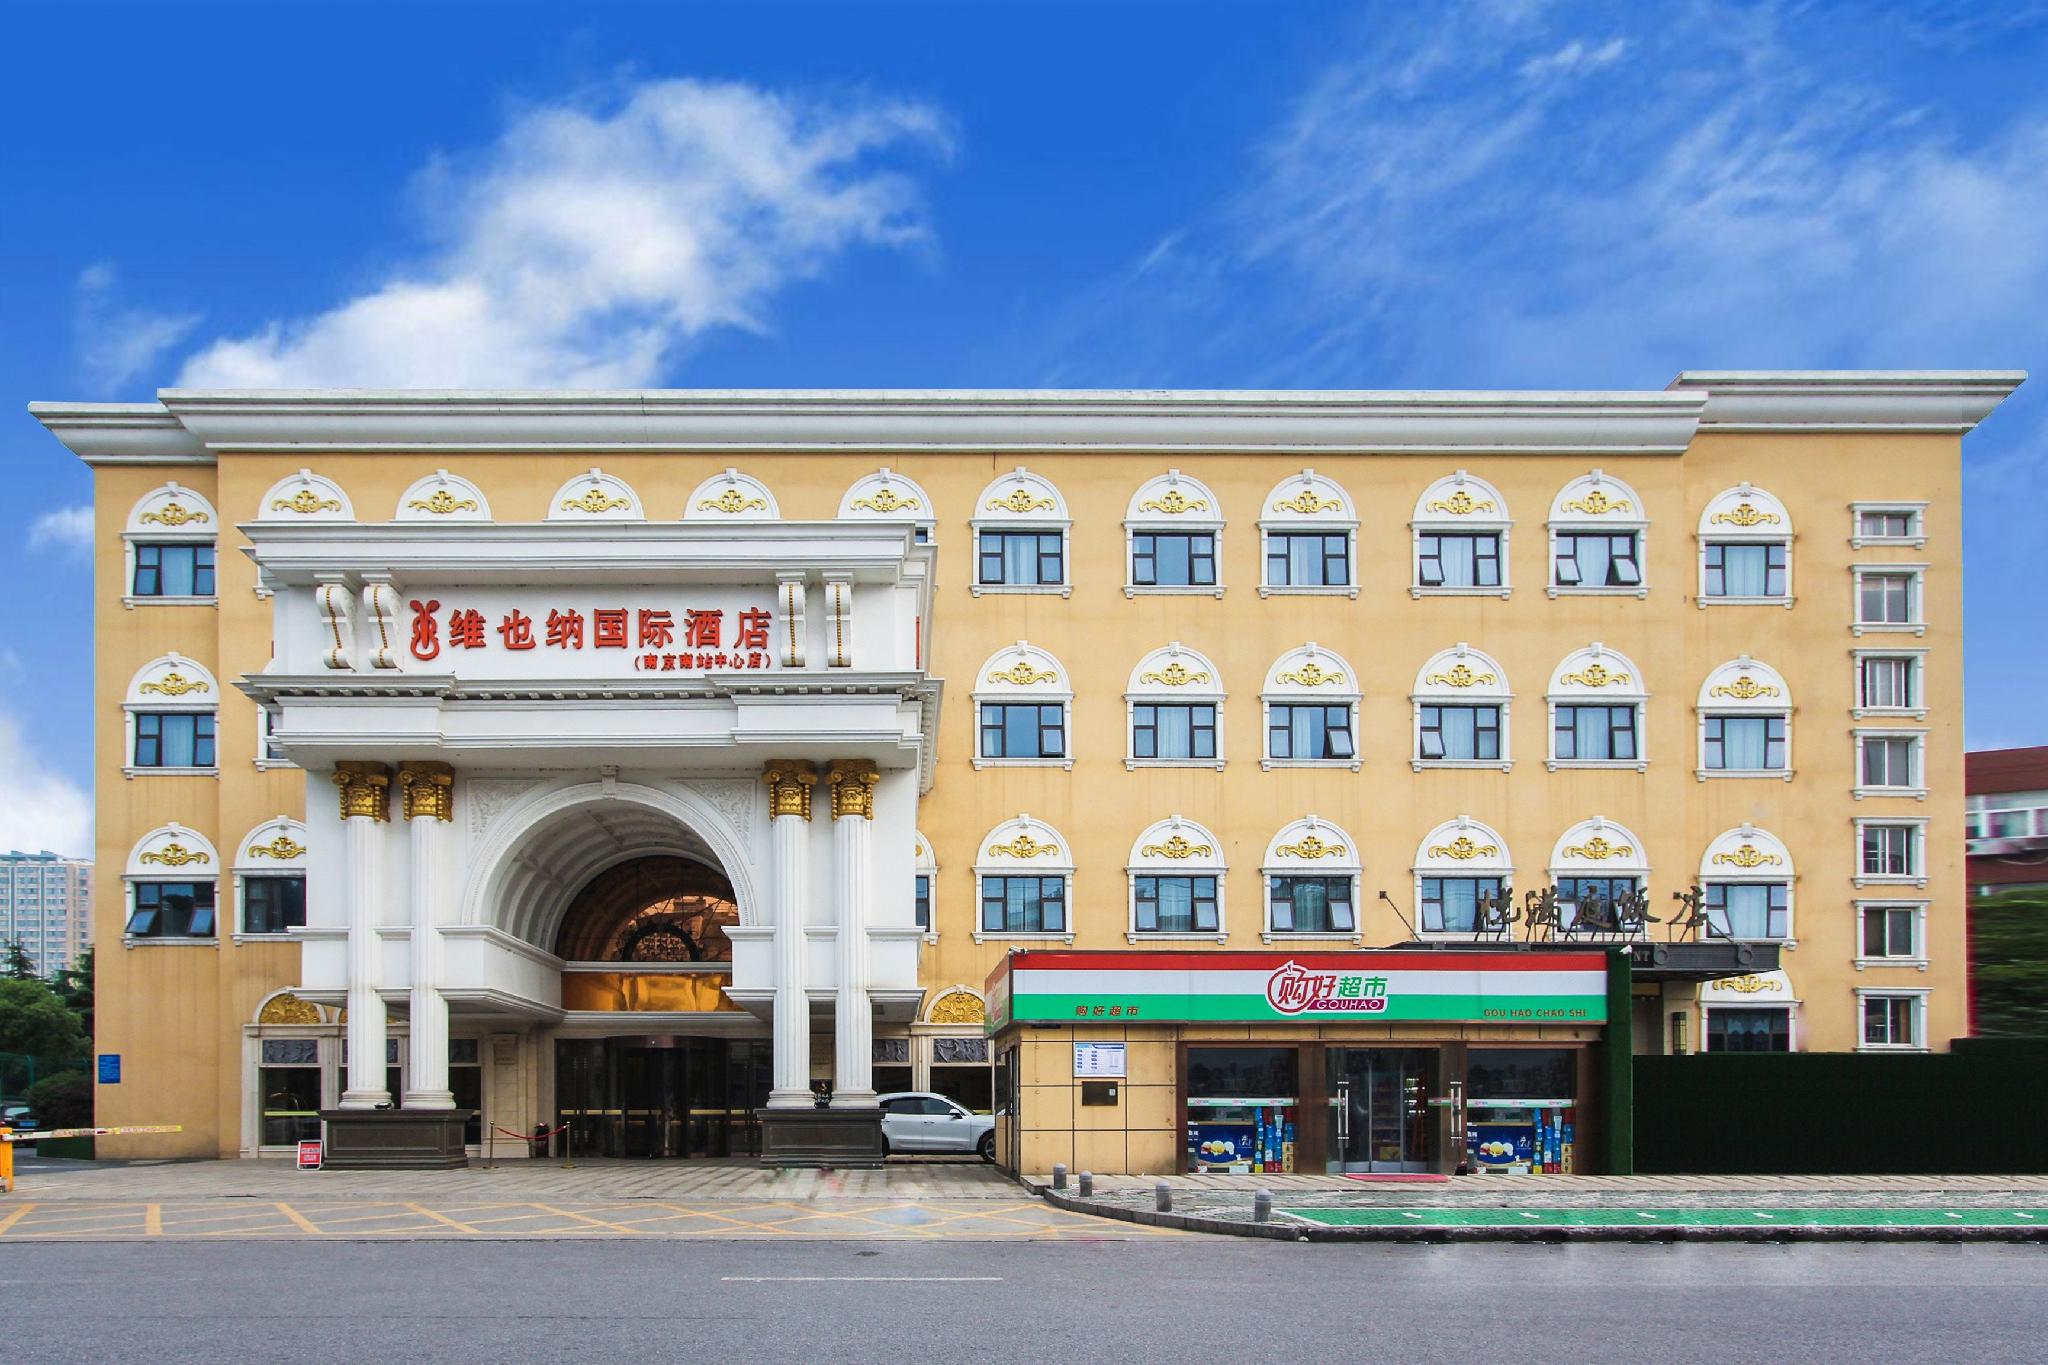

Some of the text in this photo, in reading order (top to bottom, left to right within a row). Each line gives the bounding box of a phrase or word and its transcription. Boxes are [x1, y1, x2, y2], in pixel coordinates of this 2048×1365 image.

[448, 607, 773, 650] 维也纳国际酒店
[1270, 967, 1388, 1007] 购好超市
[1316, 1000, 1381, 1009] GOUHAO
[1075, 1005, 1139, 1016] 购好超市
[1483, 1008, 1587, 1017] GOU HAO CHAO SHI
